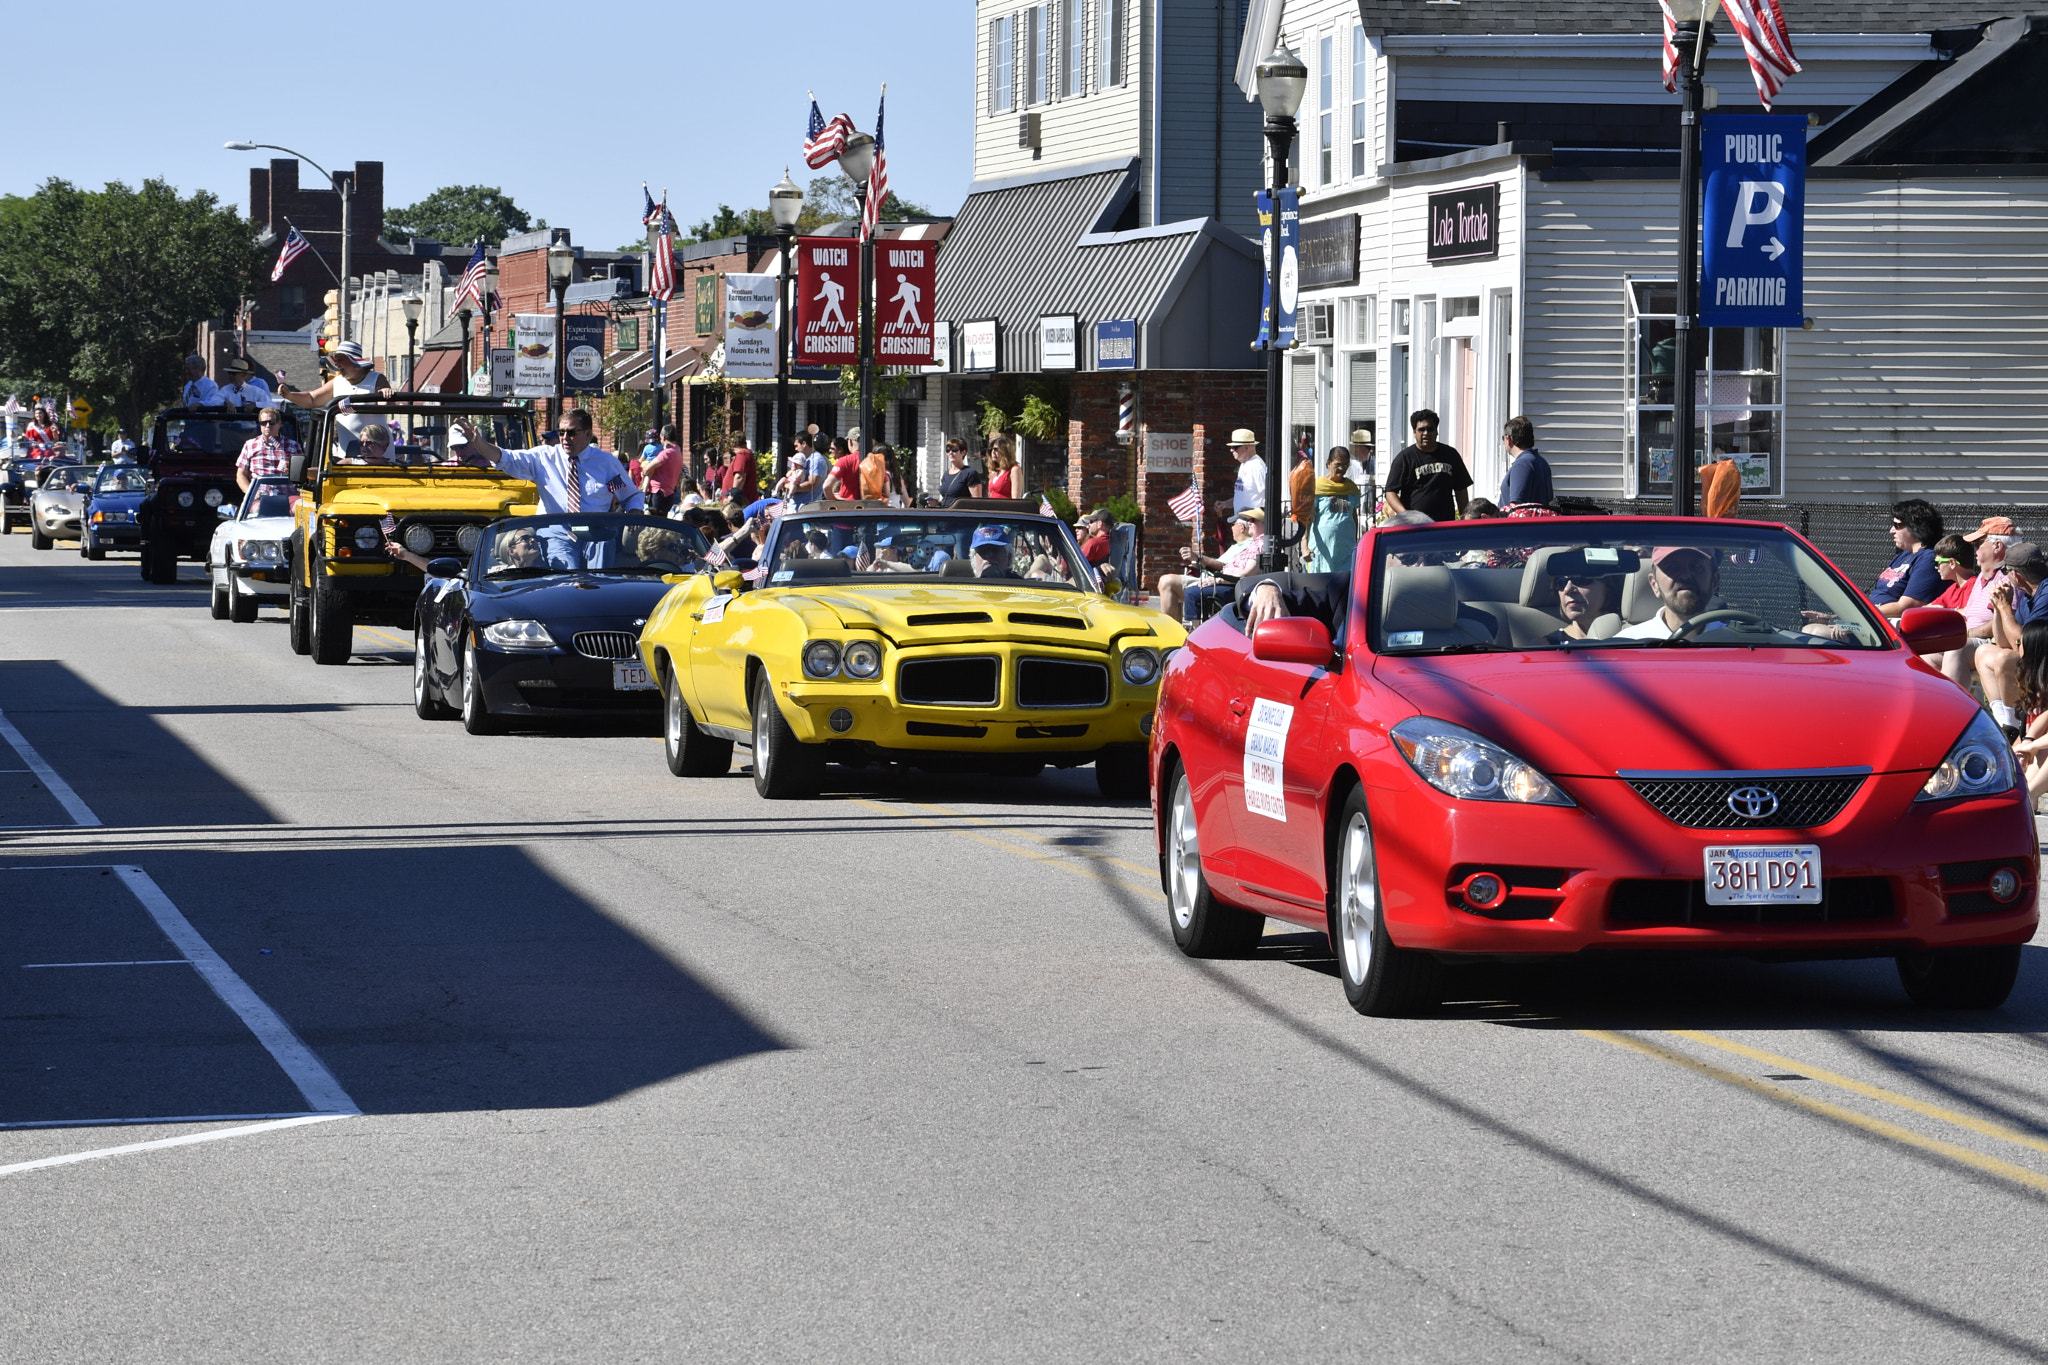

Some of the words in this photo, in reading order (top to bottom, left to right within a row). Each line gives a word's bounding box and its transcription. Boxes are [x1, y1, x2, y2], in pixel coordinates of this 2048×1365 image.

[1725, 134, 1783, 163] PUBLIC
[1726, 181, 1785, 248] P
[1433, 206, 1453, 246] Lola
[1457, 202, 1488, 244] Tortola
[812, 248, 848, 266] WATCH
[889, 250, 924, 268] WATCH
[1716, 277, 1787, 306] PARKING
[567, 326, 604, 334] Experience
[738, 338, 763, 346] Sundays
[805, 335, 854, 353] CROSSING
[881, 337, 930, 355] CROSSING
[495, 355, 515, 363] RIGHT
[495, 385, 513, 393] TURN
[1151, 439, 1188, 450] SHOE
[1147, 456, 1193, 468] REPAIR
[1415, 462, 1453, 480] PURDUE
[1709, 849, 1726, 858] JAN
[1730, 848, 1794, 859] Massachusetts
[1711, 860, 1760, 890] 38H
[1766, 860, 1816, 890] D91
